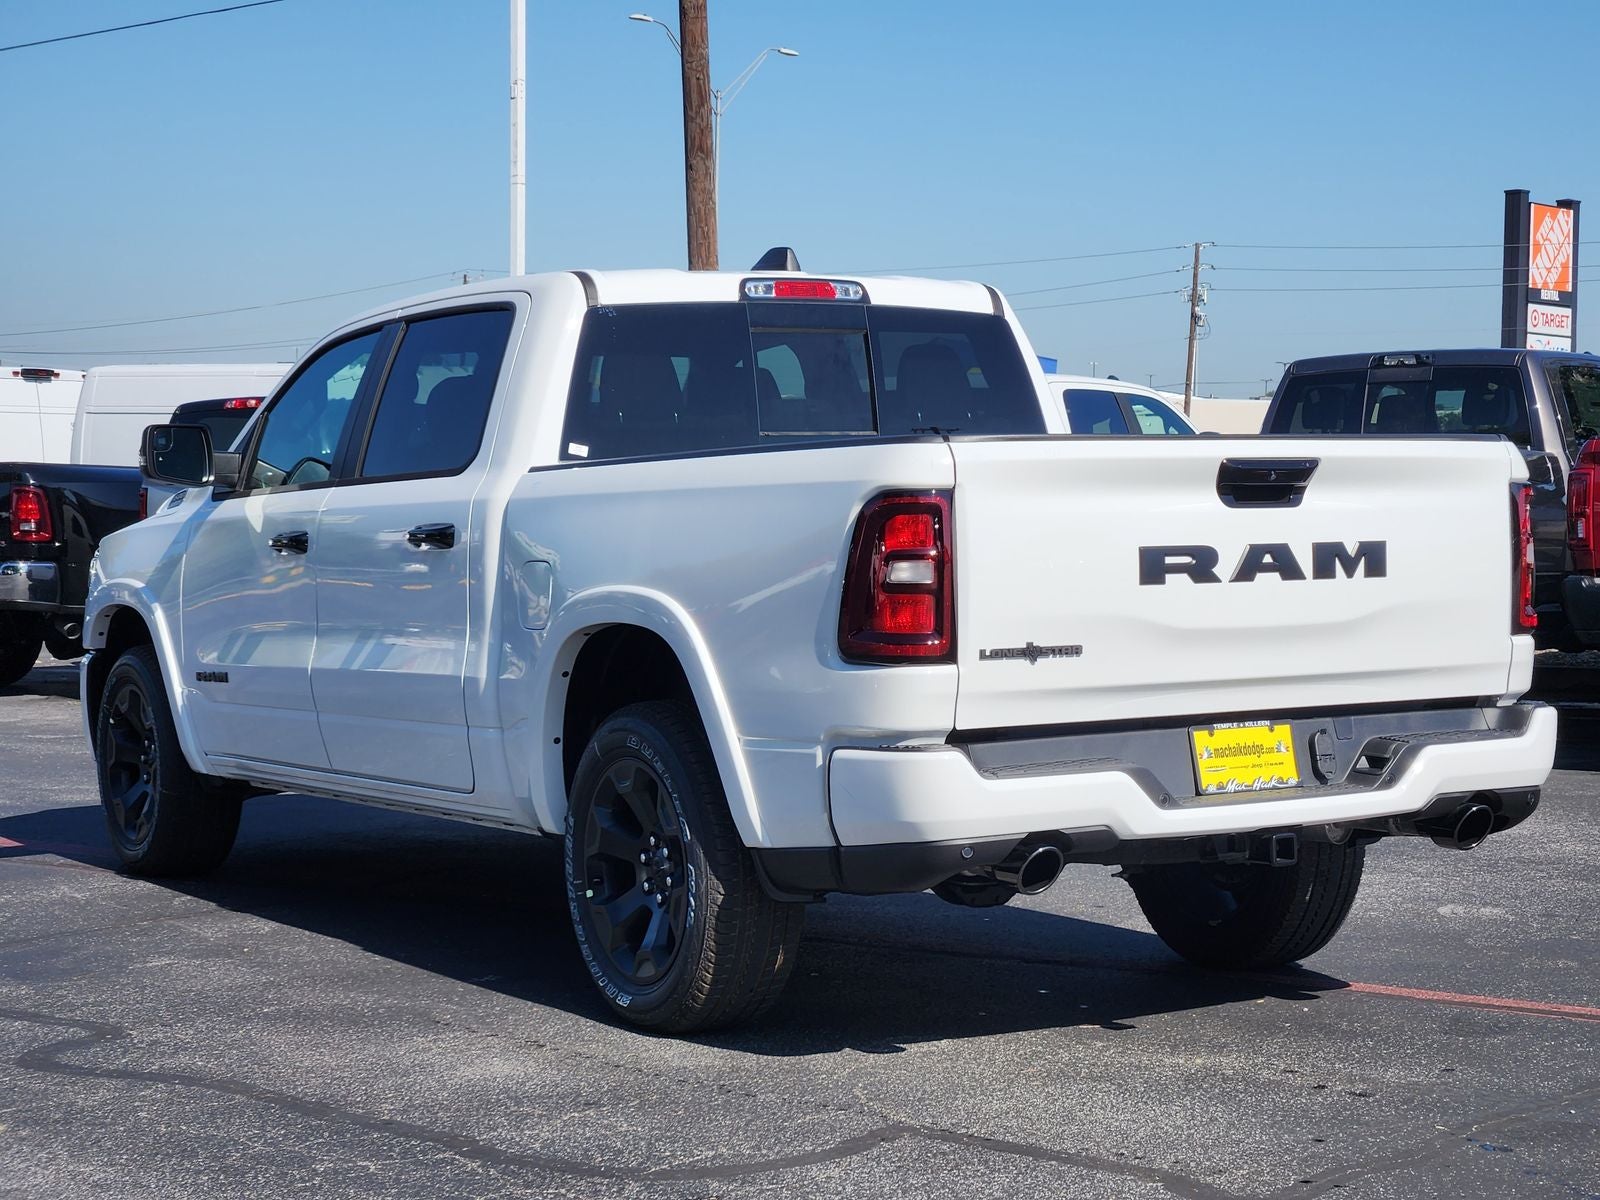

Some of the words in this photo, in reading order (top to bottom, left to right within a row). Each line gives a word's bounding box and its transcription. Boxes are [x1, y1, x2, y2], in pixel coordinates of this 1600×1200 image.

[1536, 211, 1554, 245] THE
[1532, 208, 1570, 288] HOME
[1547, 238, 1570, 288] DEPOT
[1541, 312, 1570, 328] TARGET
[1139, 541, 1387, 585] RAM
[979, 648, 1024, 661] LONE
[1040, 645, 1083, 658] STAR
[1213, 722, 1238, 730] TEMPLE
[1245, 720, 1270, 728] KILLEEN
[1213, 741, 1275, 759] machaikdodge.com
